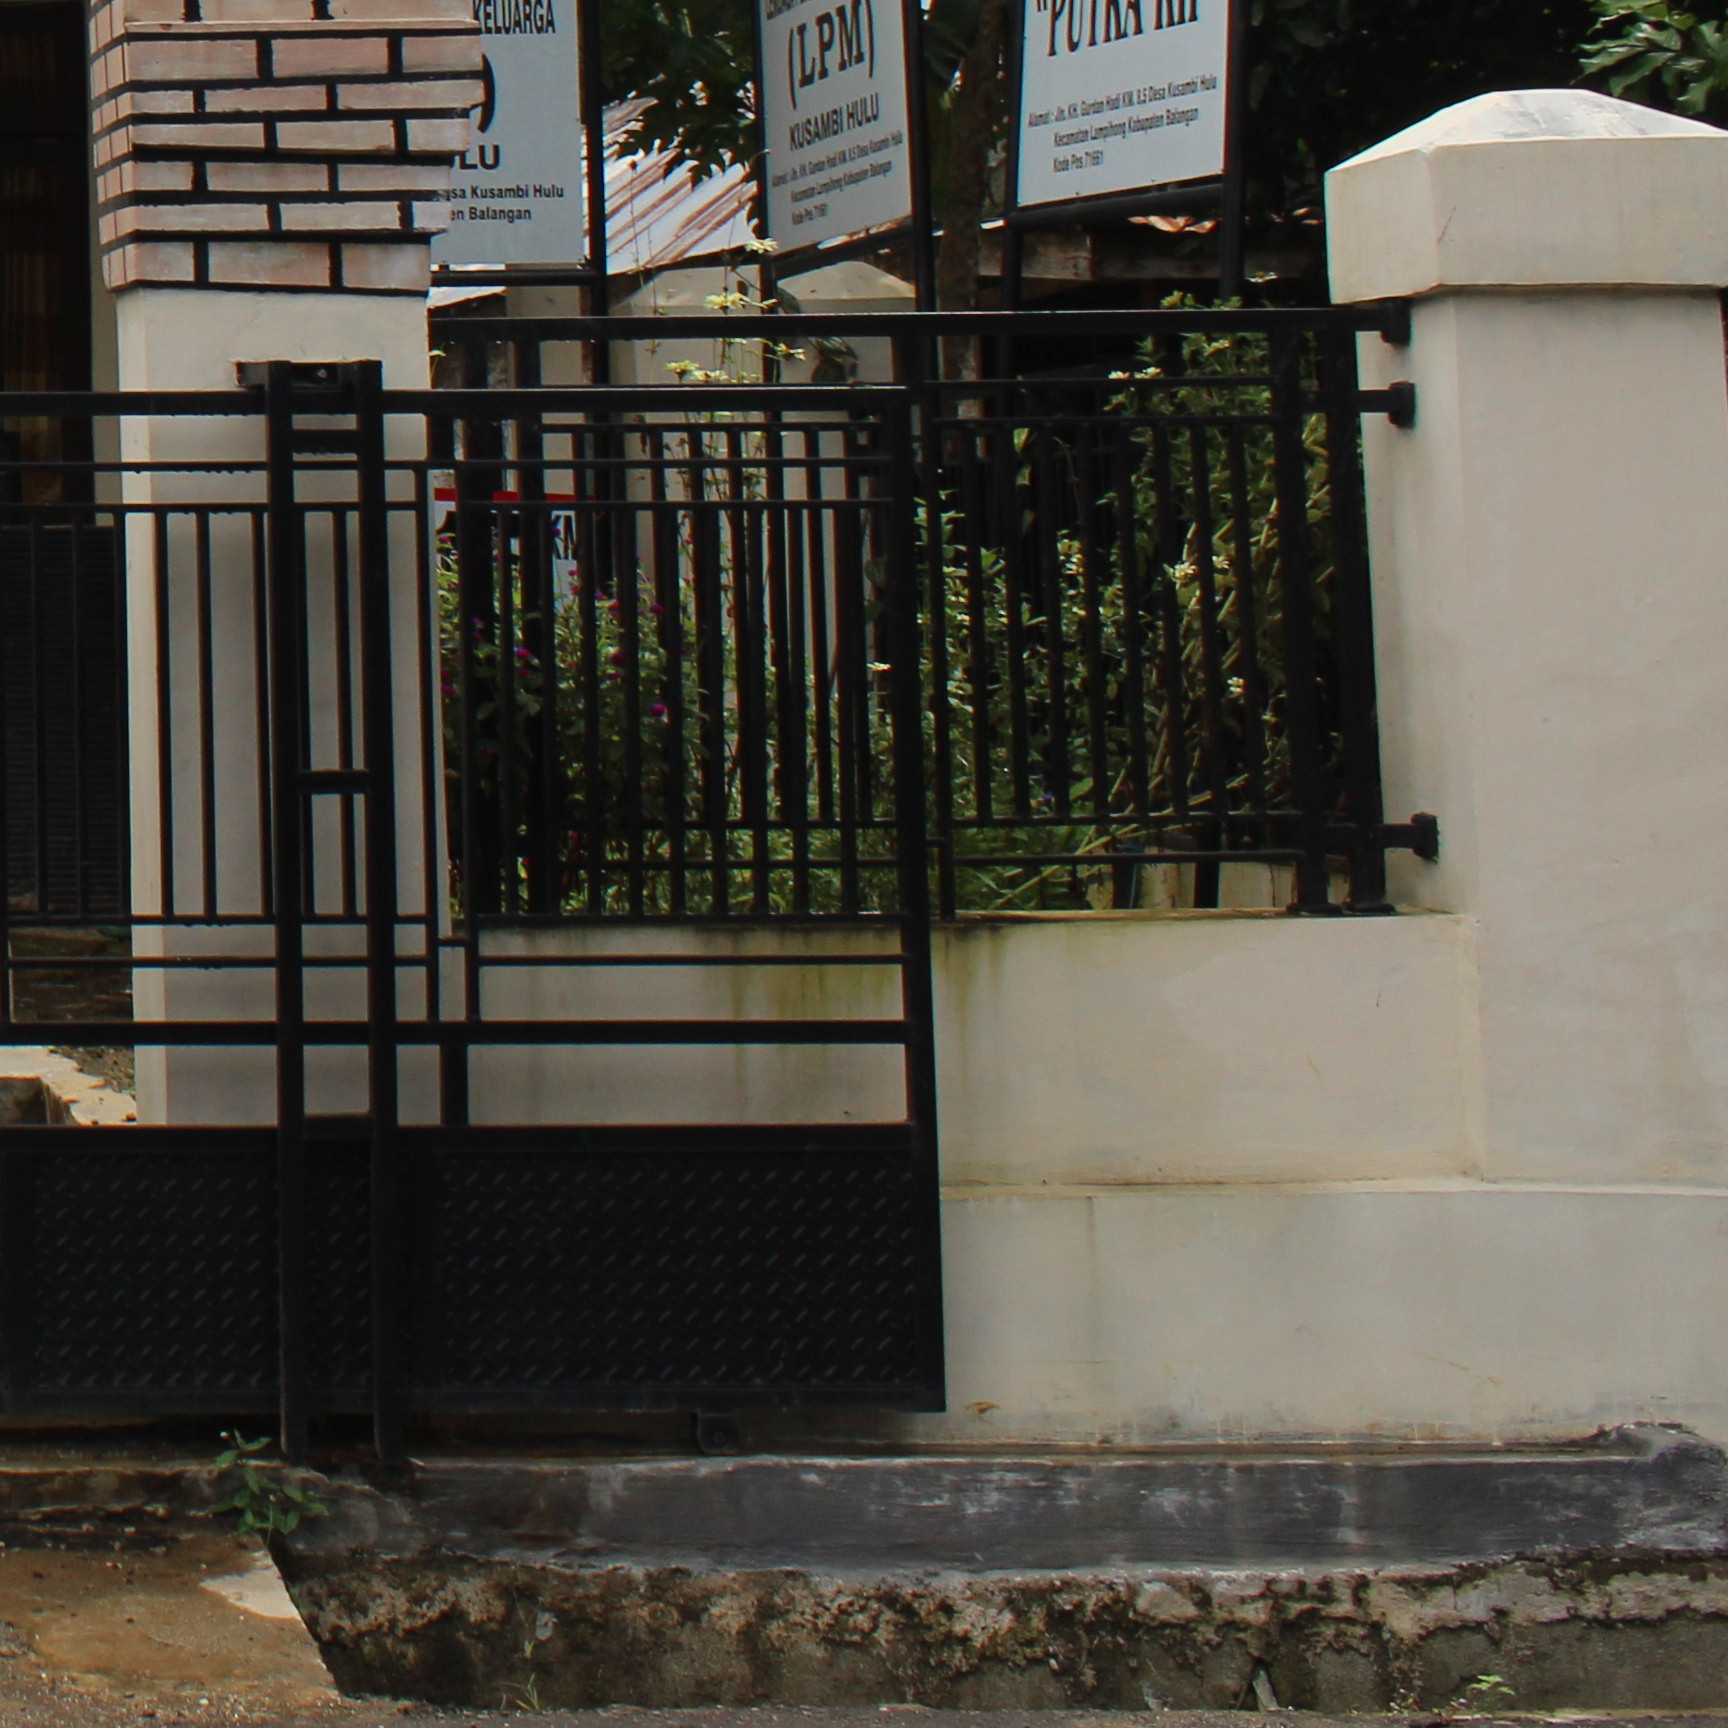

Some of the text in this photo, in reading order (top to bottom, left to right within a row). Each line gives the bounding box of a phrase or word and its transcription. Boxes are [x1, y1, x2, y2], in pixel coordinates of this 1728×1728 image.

[789, 91, 880, 152] KUSAMBI HULU
[471, 185, 529, 199] Kusambi
[533, 185, 564, 198] Hulu
[469, 207, 532, 224] Balangan
